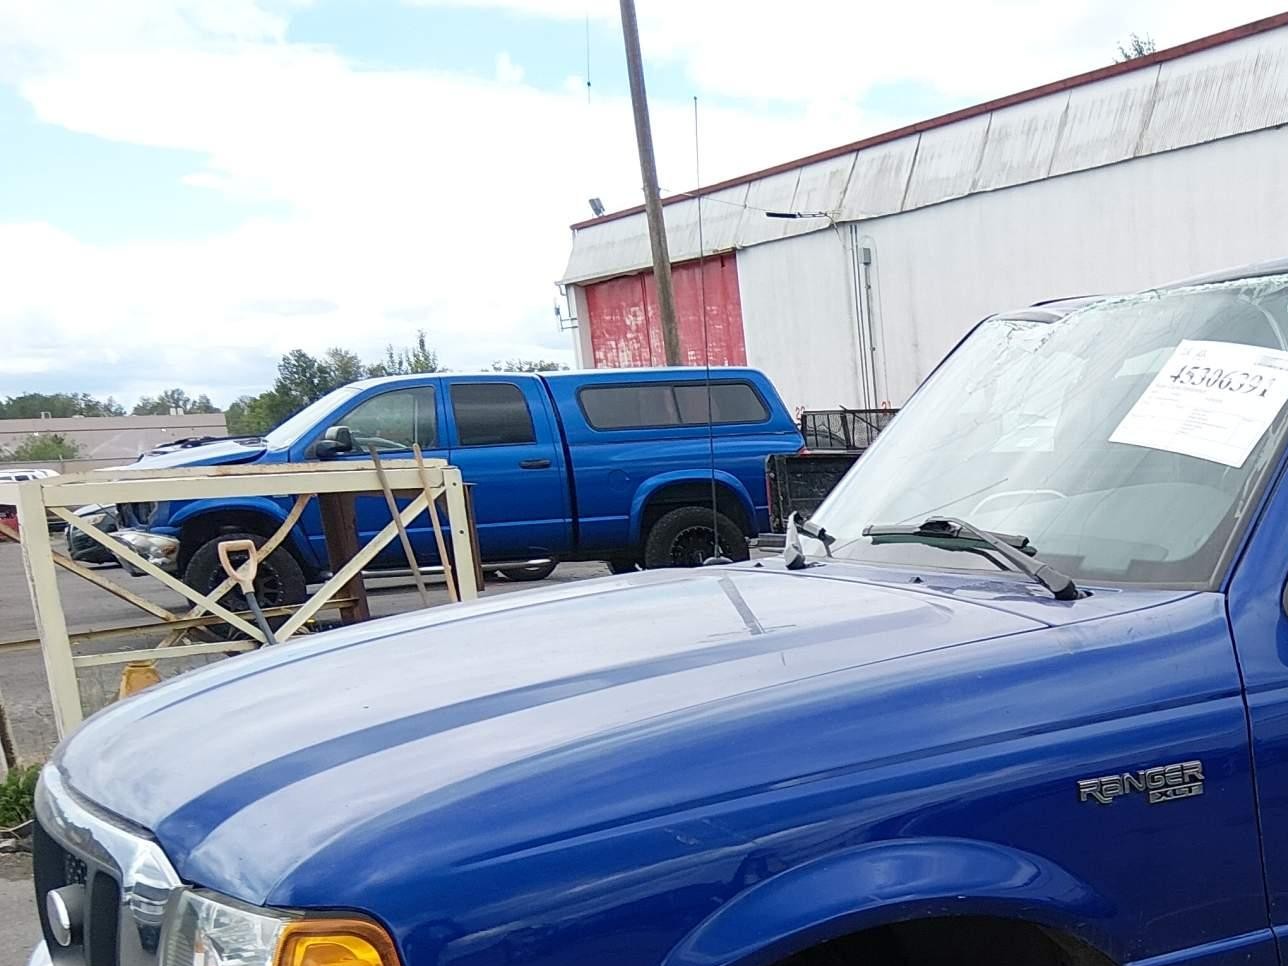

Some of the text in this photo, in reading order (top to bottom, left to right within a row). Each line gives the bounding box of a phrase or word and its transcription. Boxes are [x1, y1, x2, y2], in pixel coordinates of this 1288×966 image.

[1170, 365, 1276, 398] 45306391
[1077, 760, 1206, 804] RANGER
[1152, 783, 1202, 802] XLT
